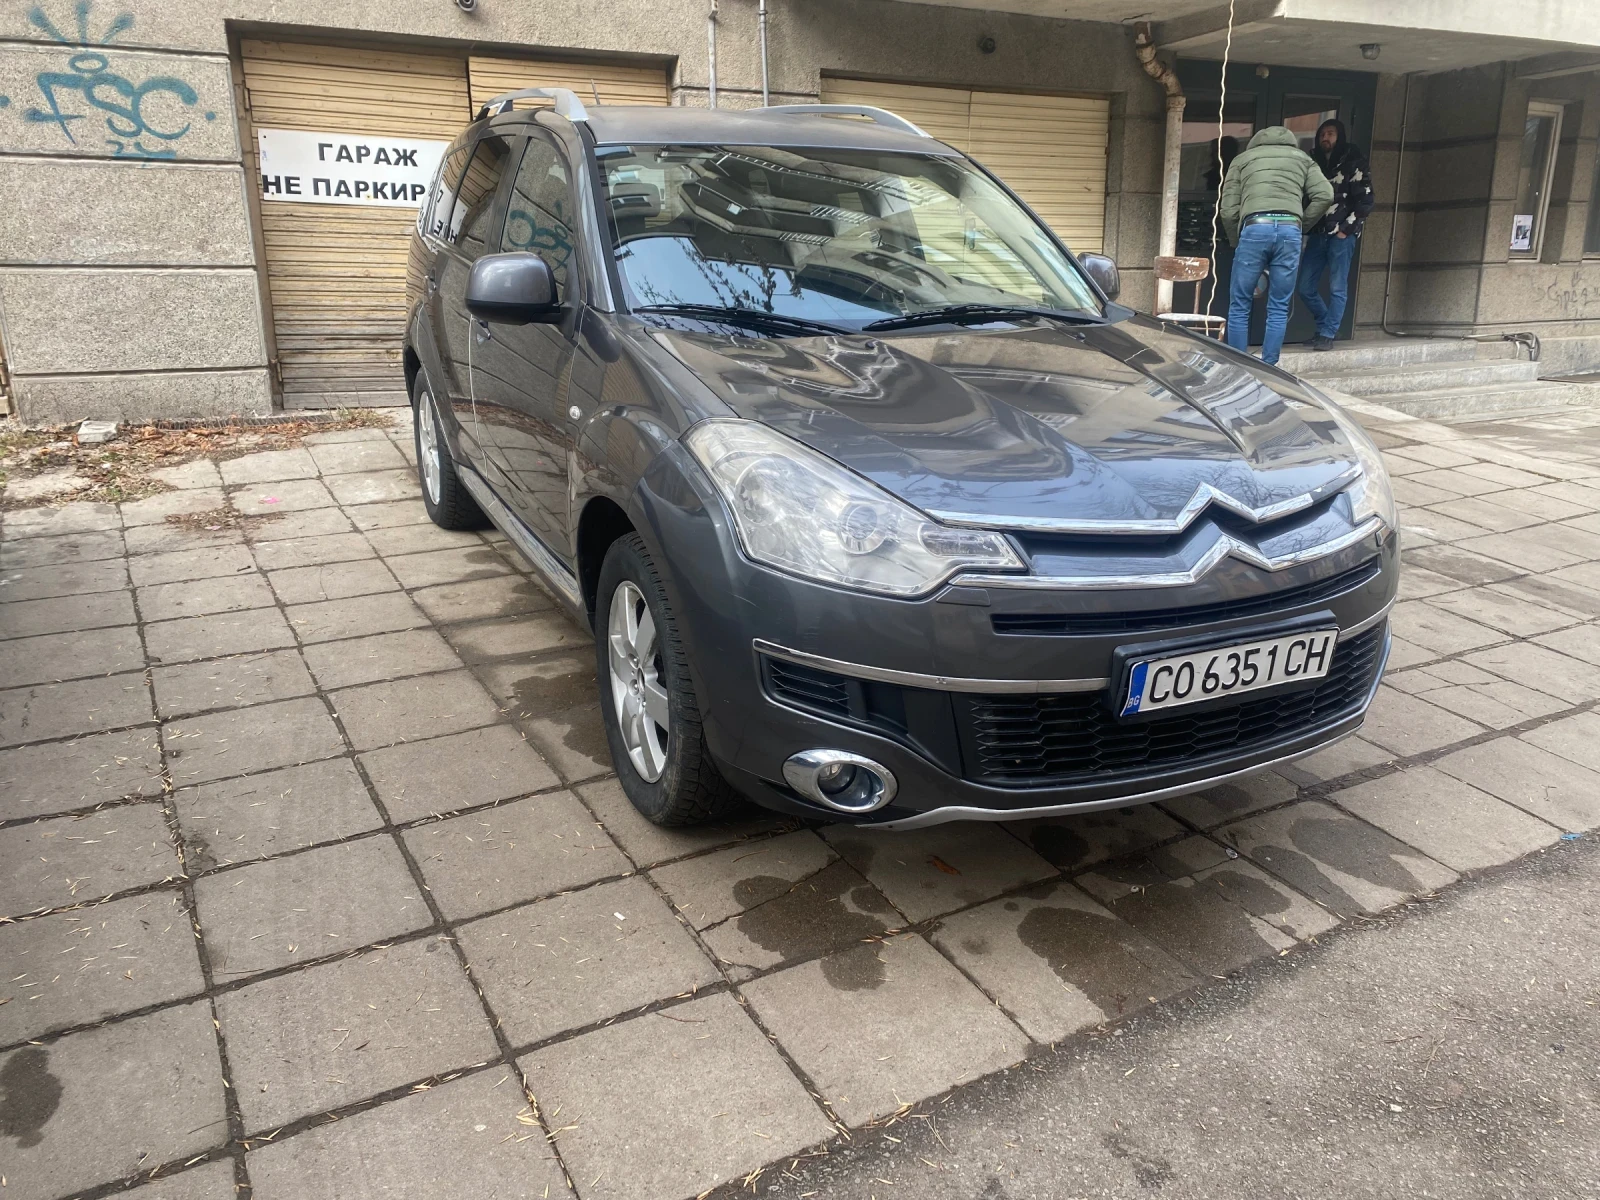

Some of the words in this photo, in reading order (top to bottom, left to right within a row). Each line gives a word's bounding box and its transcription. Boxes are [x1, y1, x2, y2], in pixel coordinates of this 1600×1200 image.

[317, 142, 418, 167] ГАРАЖ
[262, 174, 302, 195] НЕ
[312, 177, 426, 201] ПАРКИР
[1149, 661, 1195, 703] CO
[1201, 644, 1279, 694] 6351
[1284, 636, 1330, 676] CH
[1126, 694, 1140, 709] BG
